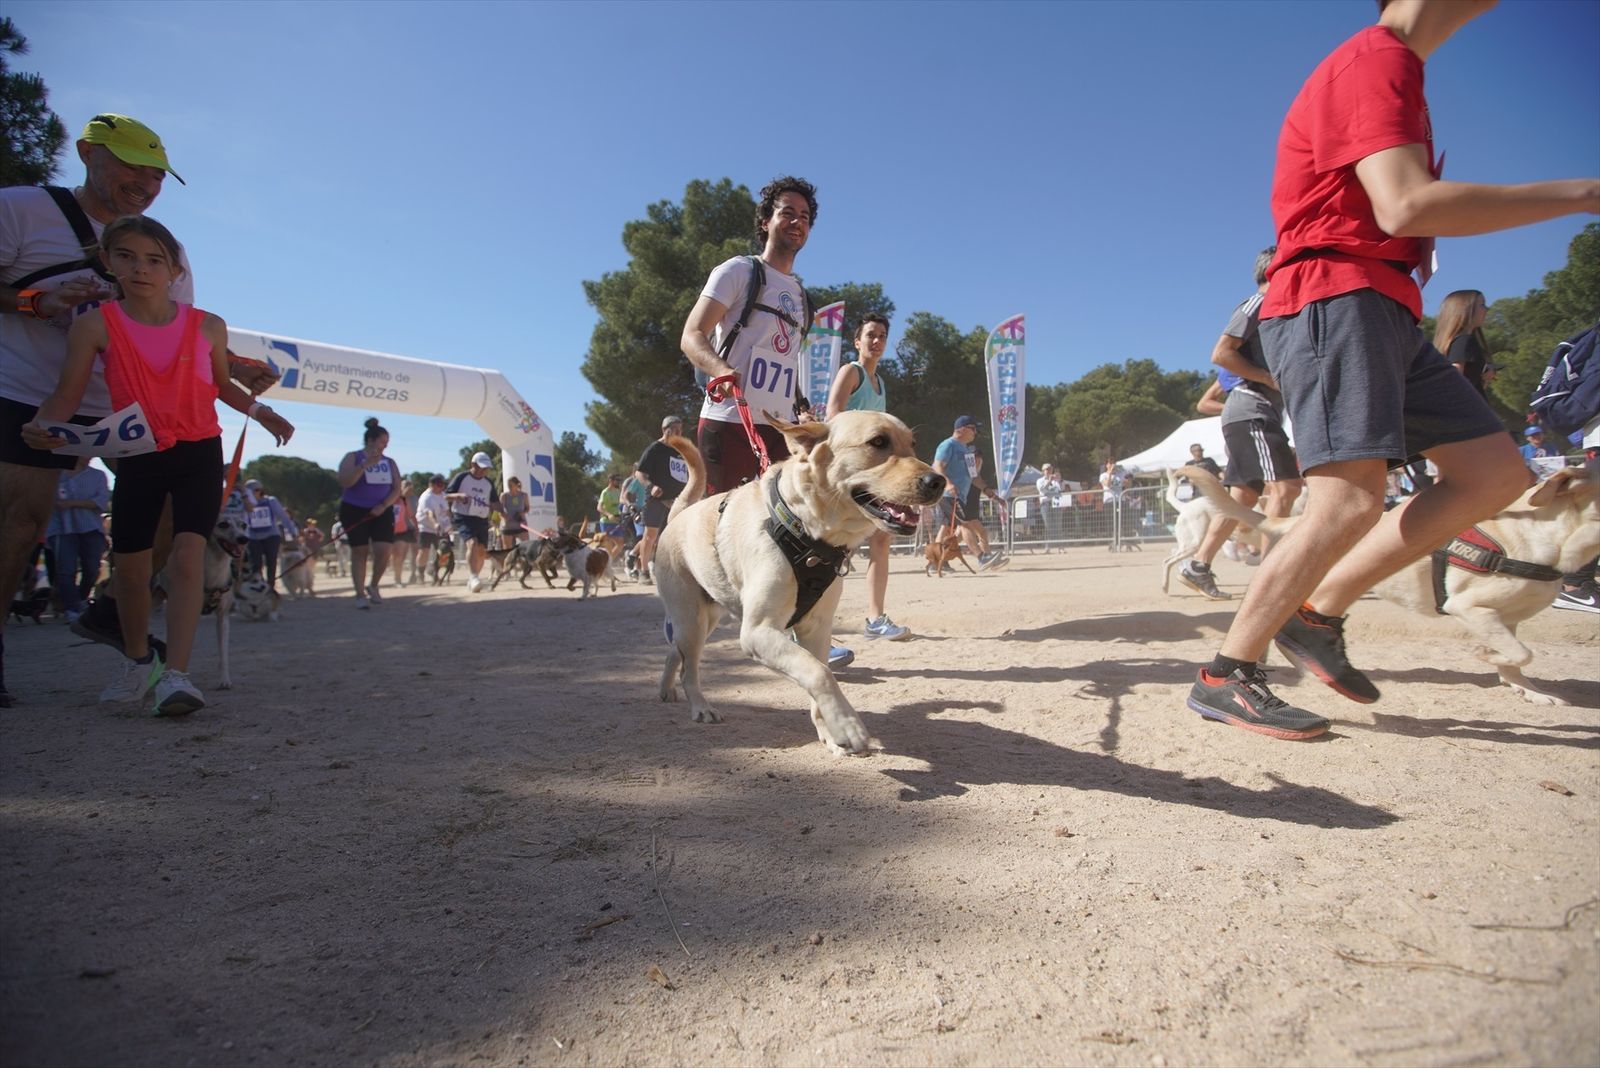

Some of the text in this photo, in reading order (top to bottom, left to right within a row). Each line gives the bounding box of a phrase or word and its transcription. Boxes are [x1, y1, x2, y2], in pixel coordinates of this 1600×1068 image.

[302, 358, 410, 384] Ayuntamiento de
[750, 357, 794, 398] 071
[299, 373, 409, 402] Las Rozas
[670, 460, 687, 473] 084
[1446, 539, 1482, 562] KIRA
